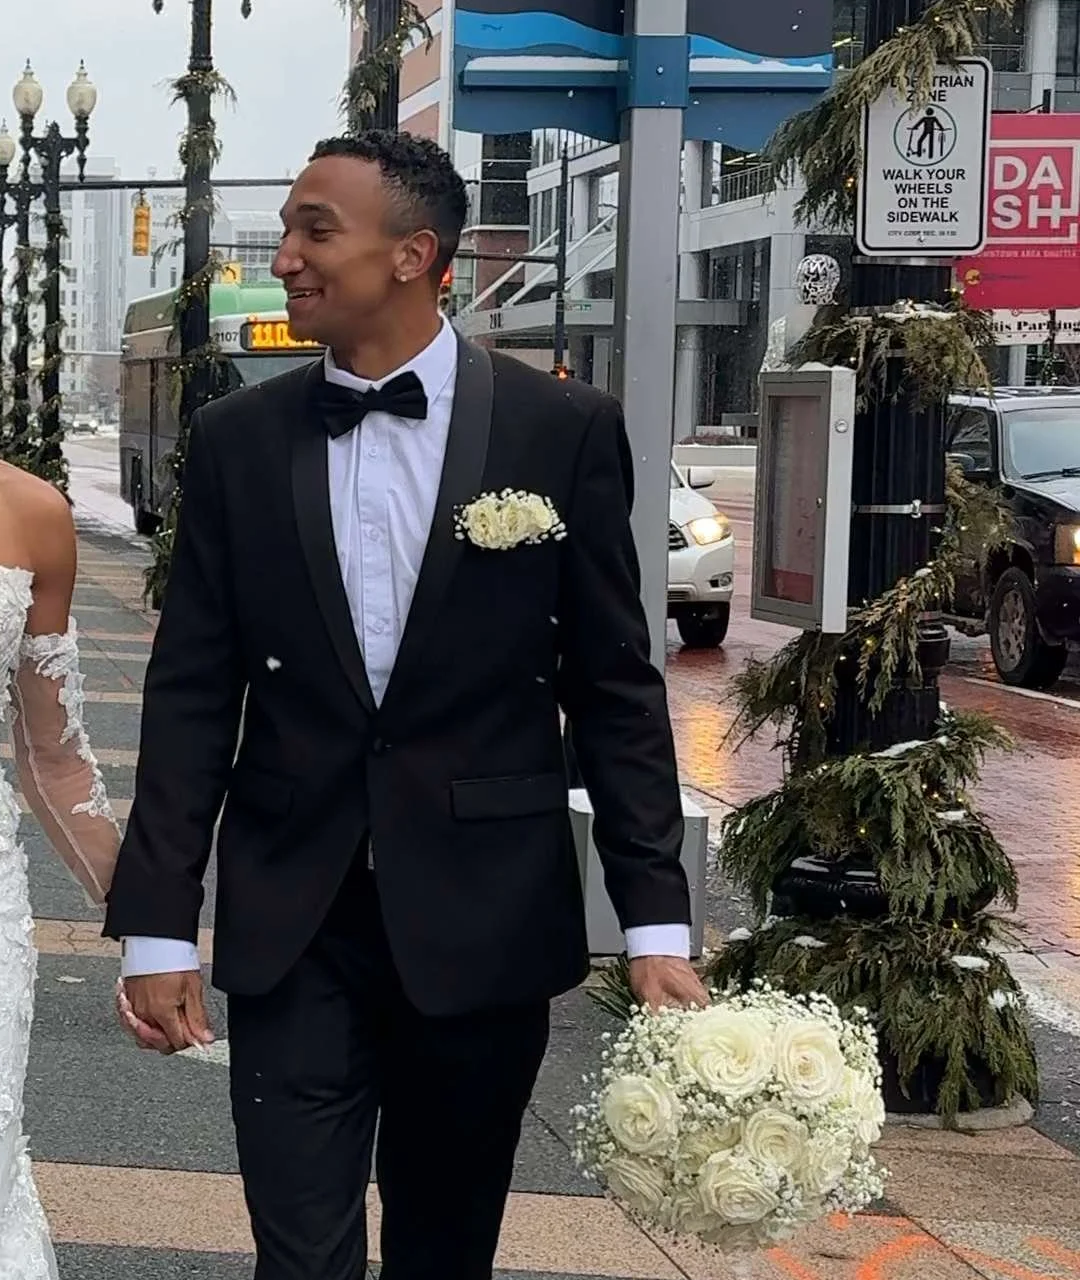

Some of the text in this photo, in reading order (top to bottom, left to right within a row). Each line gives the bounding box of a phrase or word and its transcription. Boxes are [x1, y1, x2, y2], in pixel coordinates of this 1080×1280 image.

[890, 76, 973, 87] EETRIAN
[883, 169, 966, 180] WALK YOUR
[993, 155, 1064, 190] DA
[894, 183, 953, 194] WHEELS
[898, 197, 949, 208] ON THE
[887, 212, 959, 223] SIDEWALK
[991, 194, 1061, 230] SH
